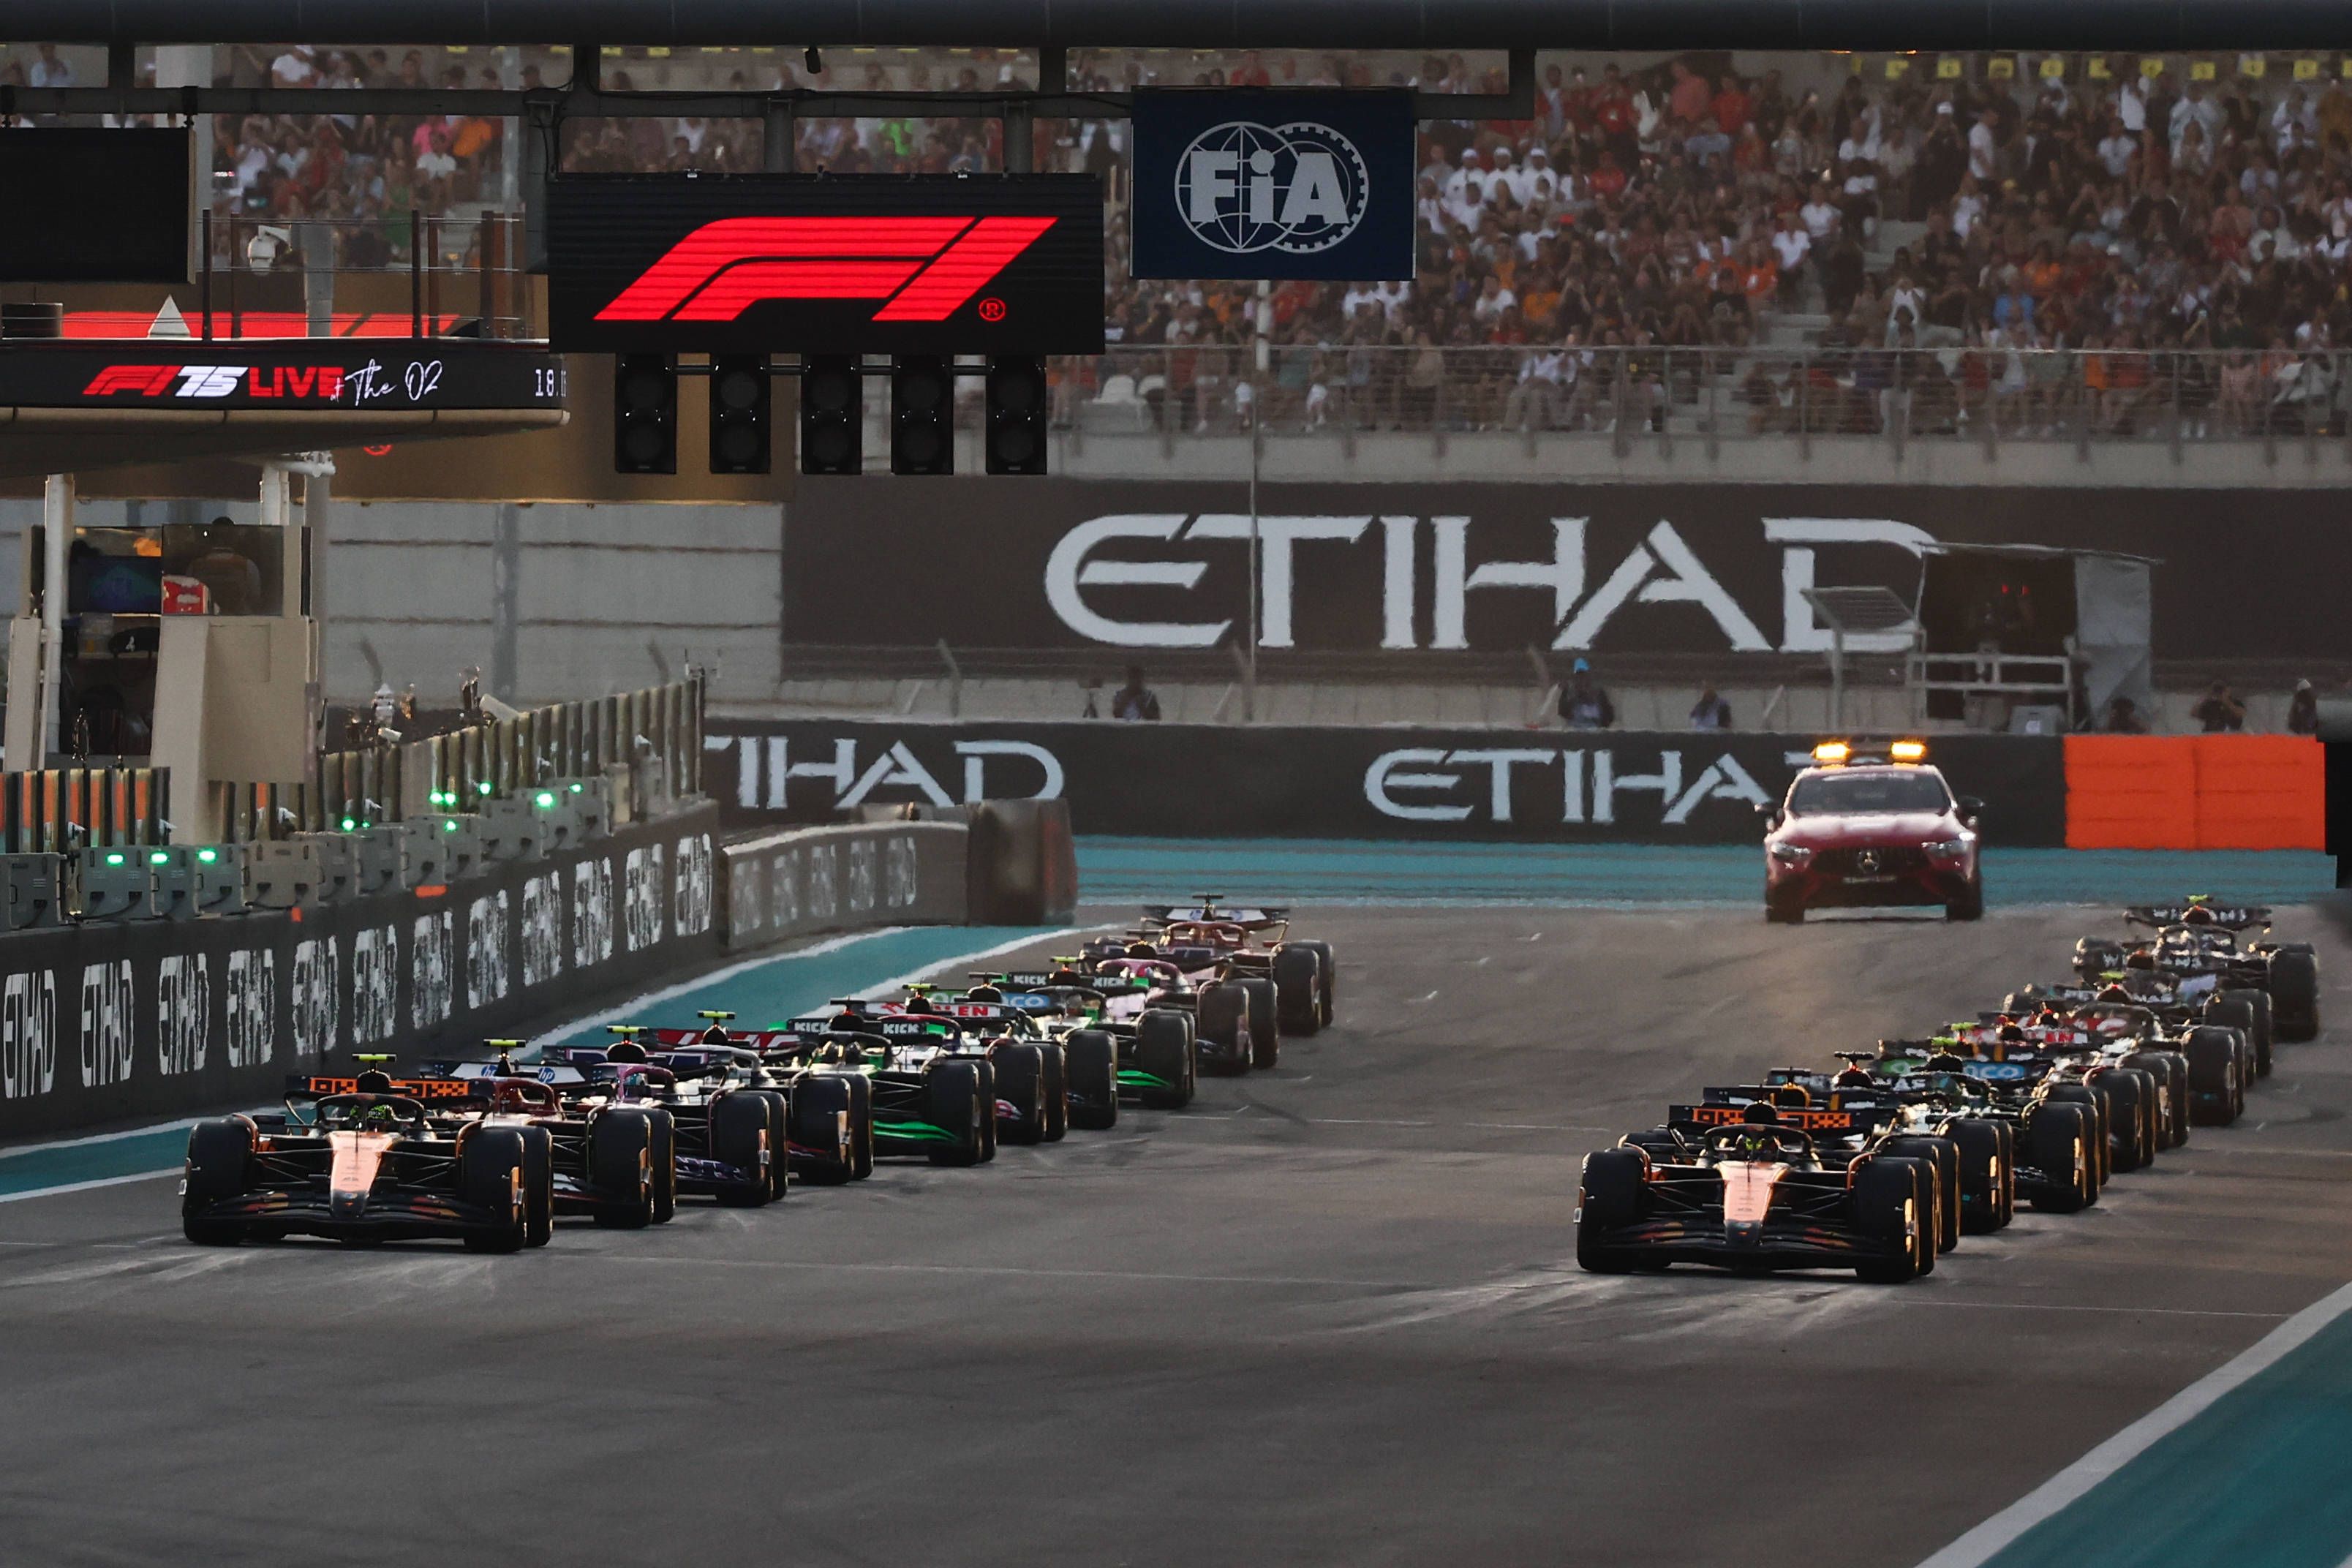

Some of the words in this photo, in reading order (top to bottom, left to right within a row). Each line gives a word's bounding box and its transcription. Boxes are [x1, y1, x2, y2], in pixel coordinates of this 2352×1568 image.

[592, 216, 1060, 320] F1
[82, 365, 183, 396] F1
[175, 366, 249, 397] 75
[249, 367, 344, 397] LIVE
[344, 358, 398, 407] The
[1045, 513, 1938, 652] ETIHAD
[704, 735, 1065, 810] IHAD
[1364, 747, 1815, 823] ETIHA
[3, 969, 56, 1098] ETIHAD
[81, 959, 134, 1088] ETIHAD
[883, 1023, 919, 1034] KICK
